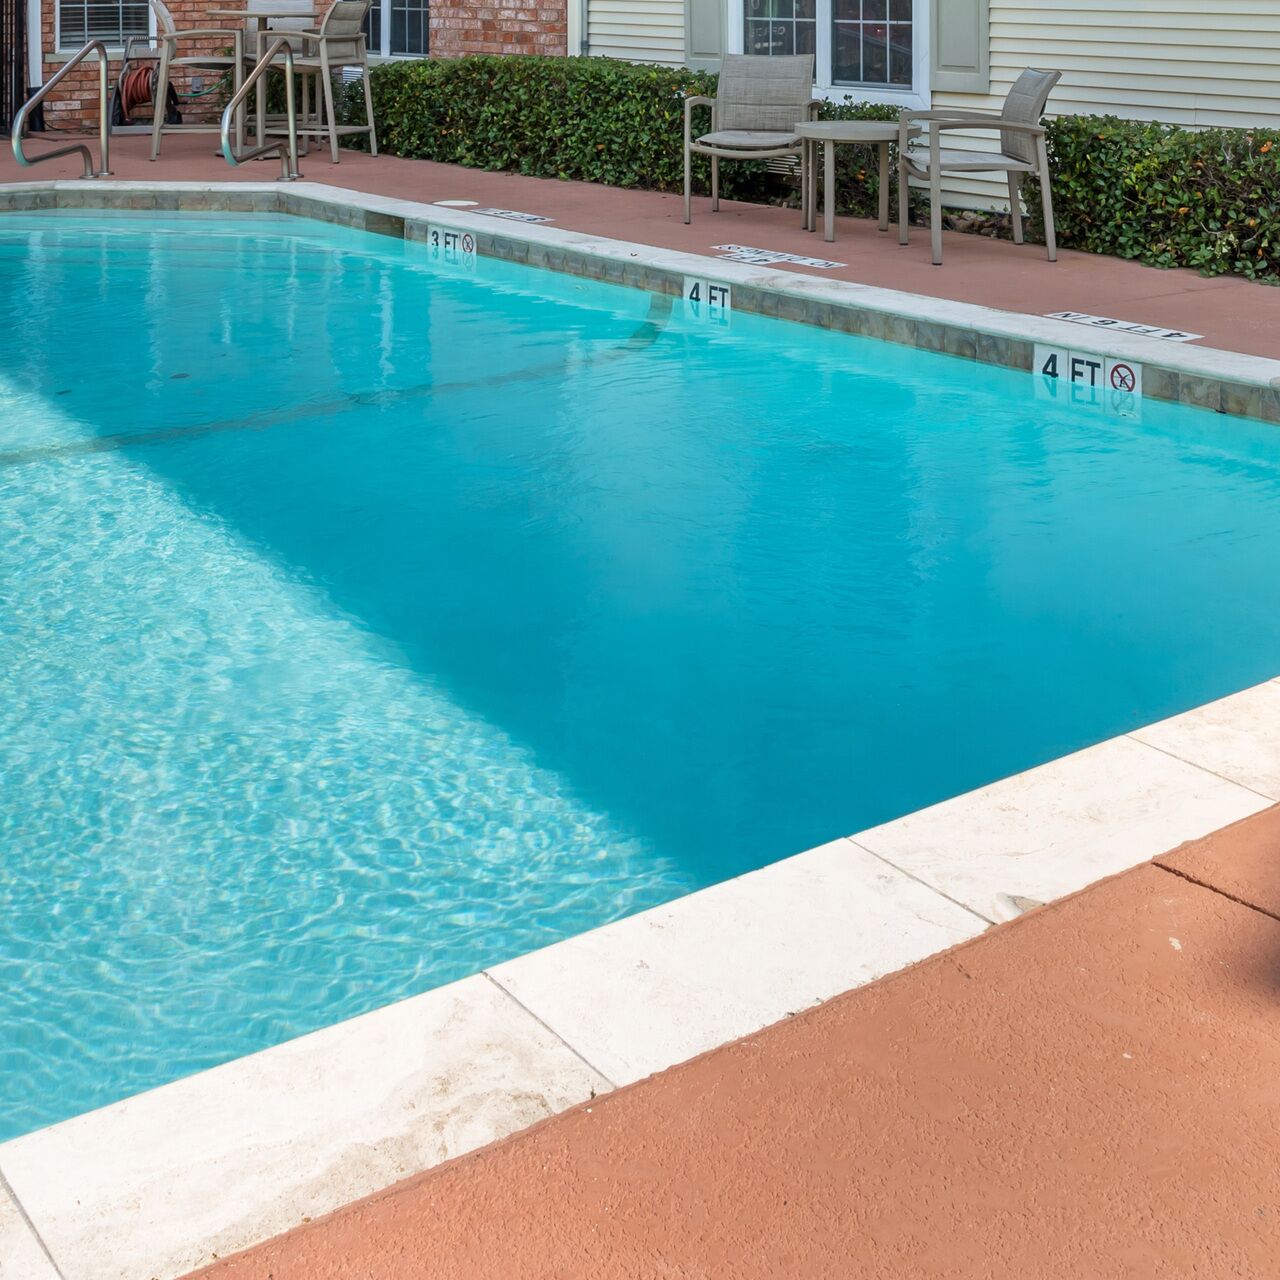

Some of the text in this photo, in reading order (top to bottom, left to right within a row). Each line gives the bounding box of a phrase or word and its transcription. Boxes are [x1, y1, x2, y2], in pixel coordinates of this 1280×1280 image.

[431, 230, 458, 250] 3 FT
[689, 282, 729, 308] 4 FT
[1053, 312, 1091, 320] IN
[1119, 325, 1161, 333] FT
[1042, 353, 1101, 387] 4 FT
